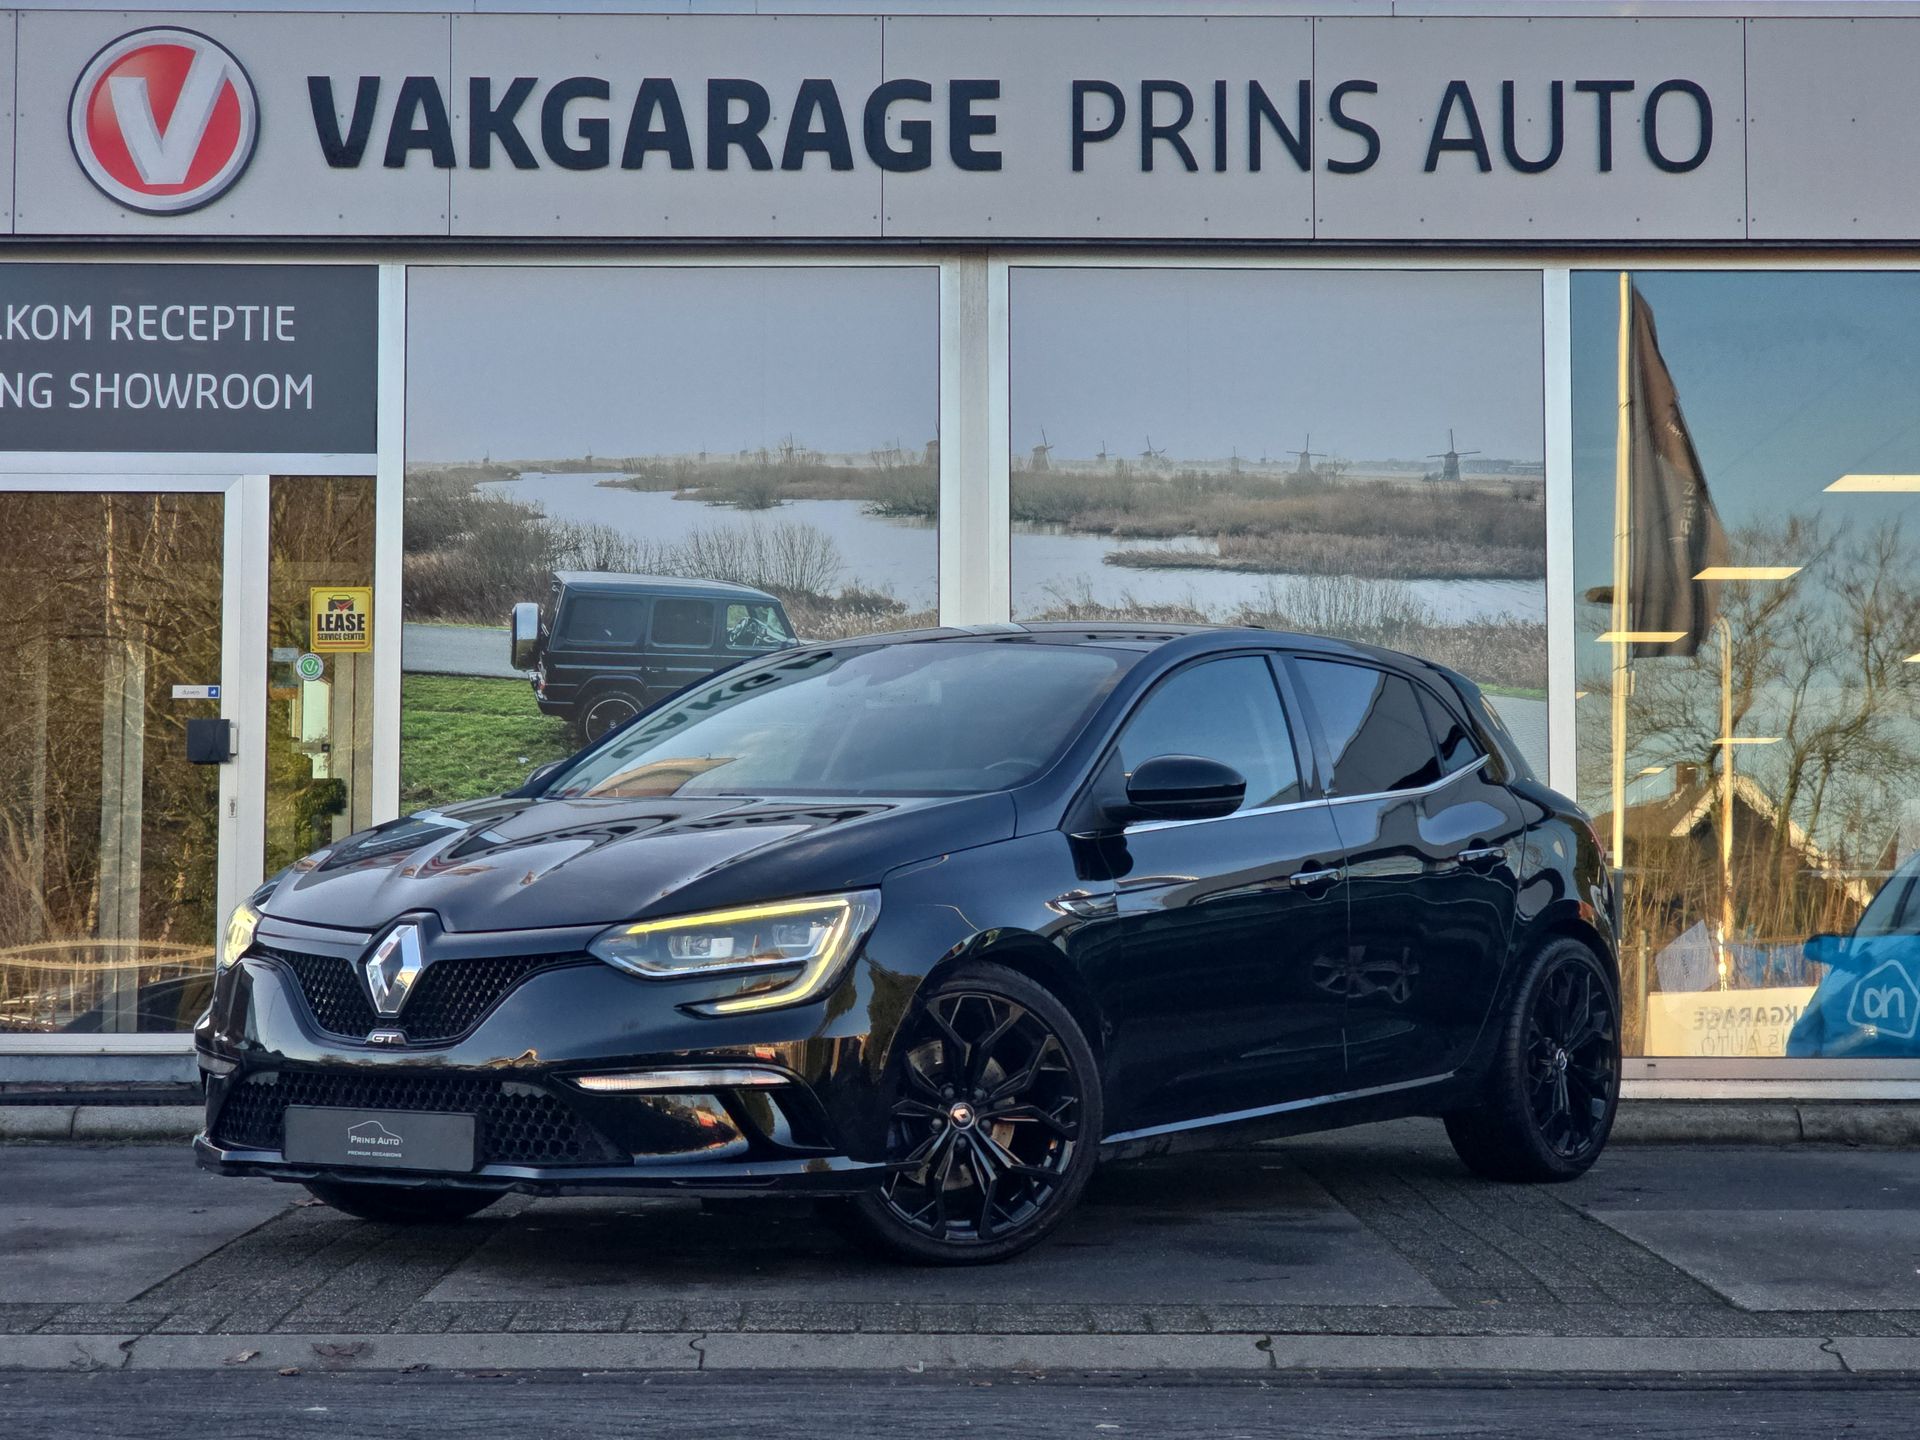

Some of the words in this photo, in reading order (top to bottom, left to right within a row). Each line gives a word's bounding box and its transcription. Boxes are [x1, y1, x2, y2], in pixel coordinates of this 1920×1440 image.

[308, 76, 1002, 172] VAKGARAGE
[1071, 79, 1380, 174] PRINS
[1425, 79, 1714, 174] AUTO
[0, 304, 92, 341] KOM
[110, 304, 296, 342] RECEPTIE
[68, 371, 313, 410] SHOWROOM
[317, 613, 366, 632] LEASE
[317, 632, 342, 641] SERVICE
[342, 632, 366, 641] CENTER
[372, 1033, 398, 1043] GT
[350, 1135, 376, 1145] PRINS
[377, 1136, 400, 1146] AUTO
